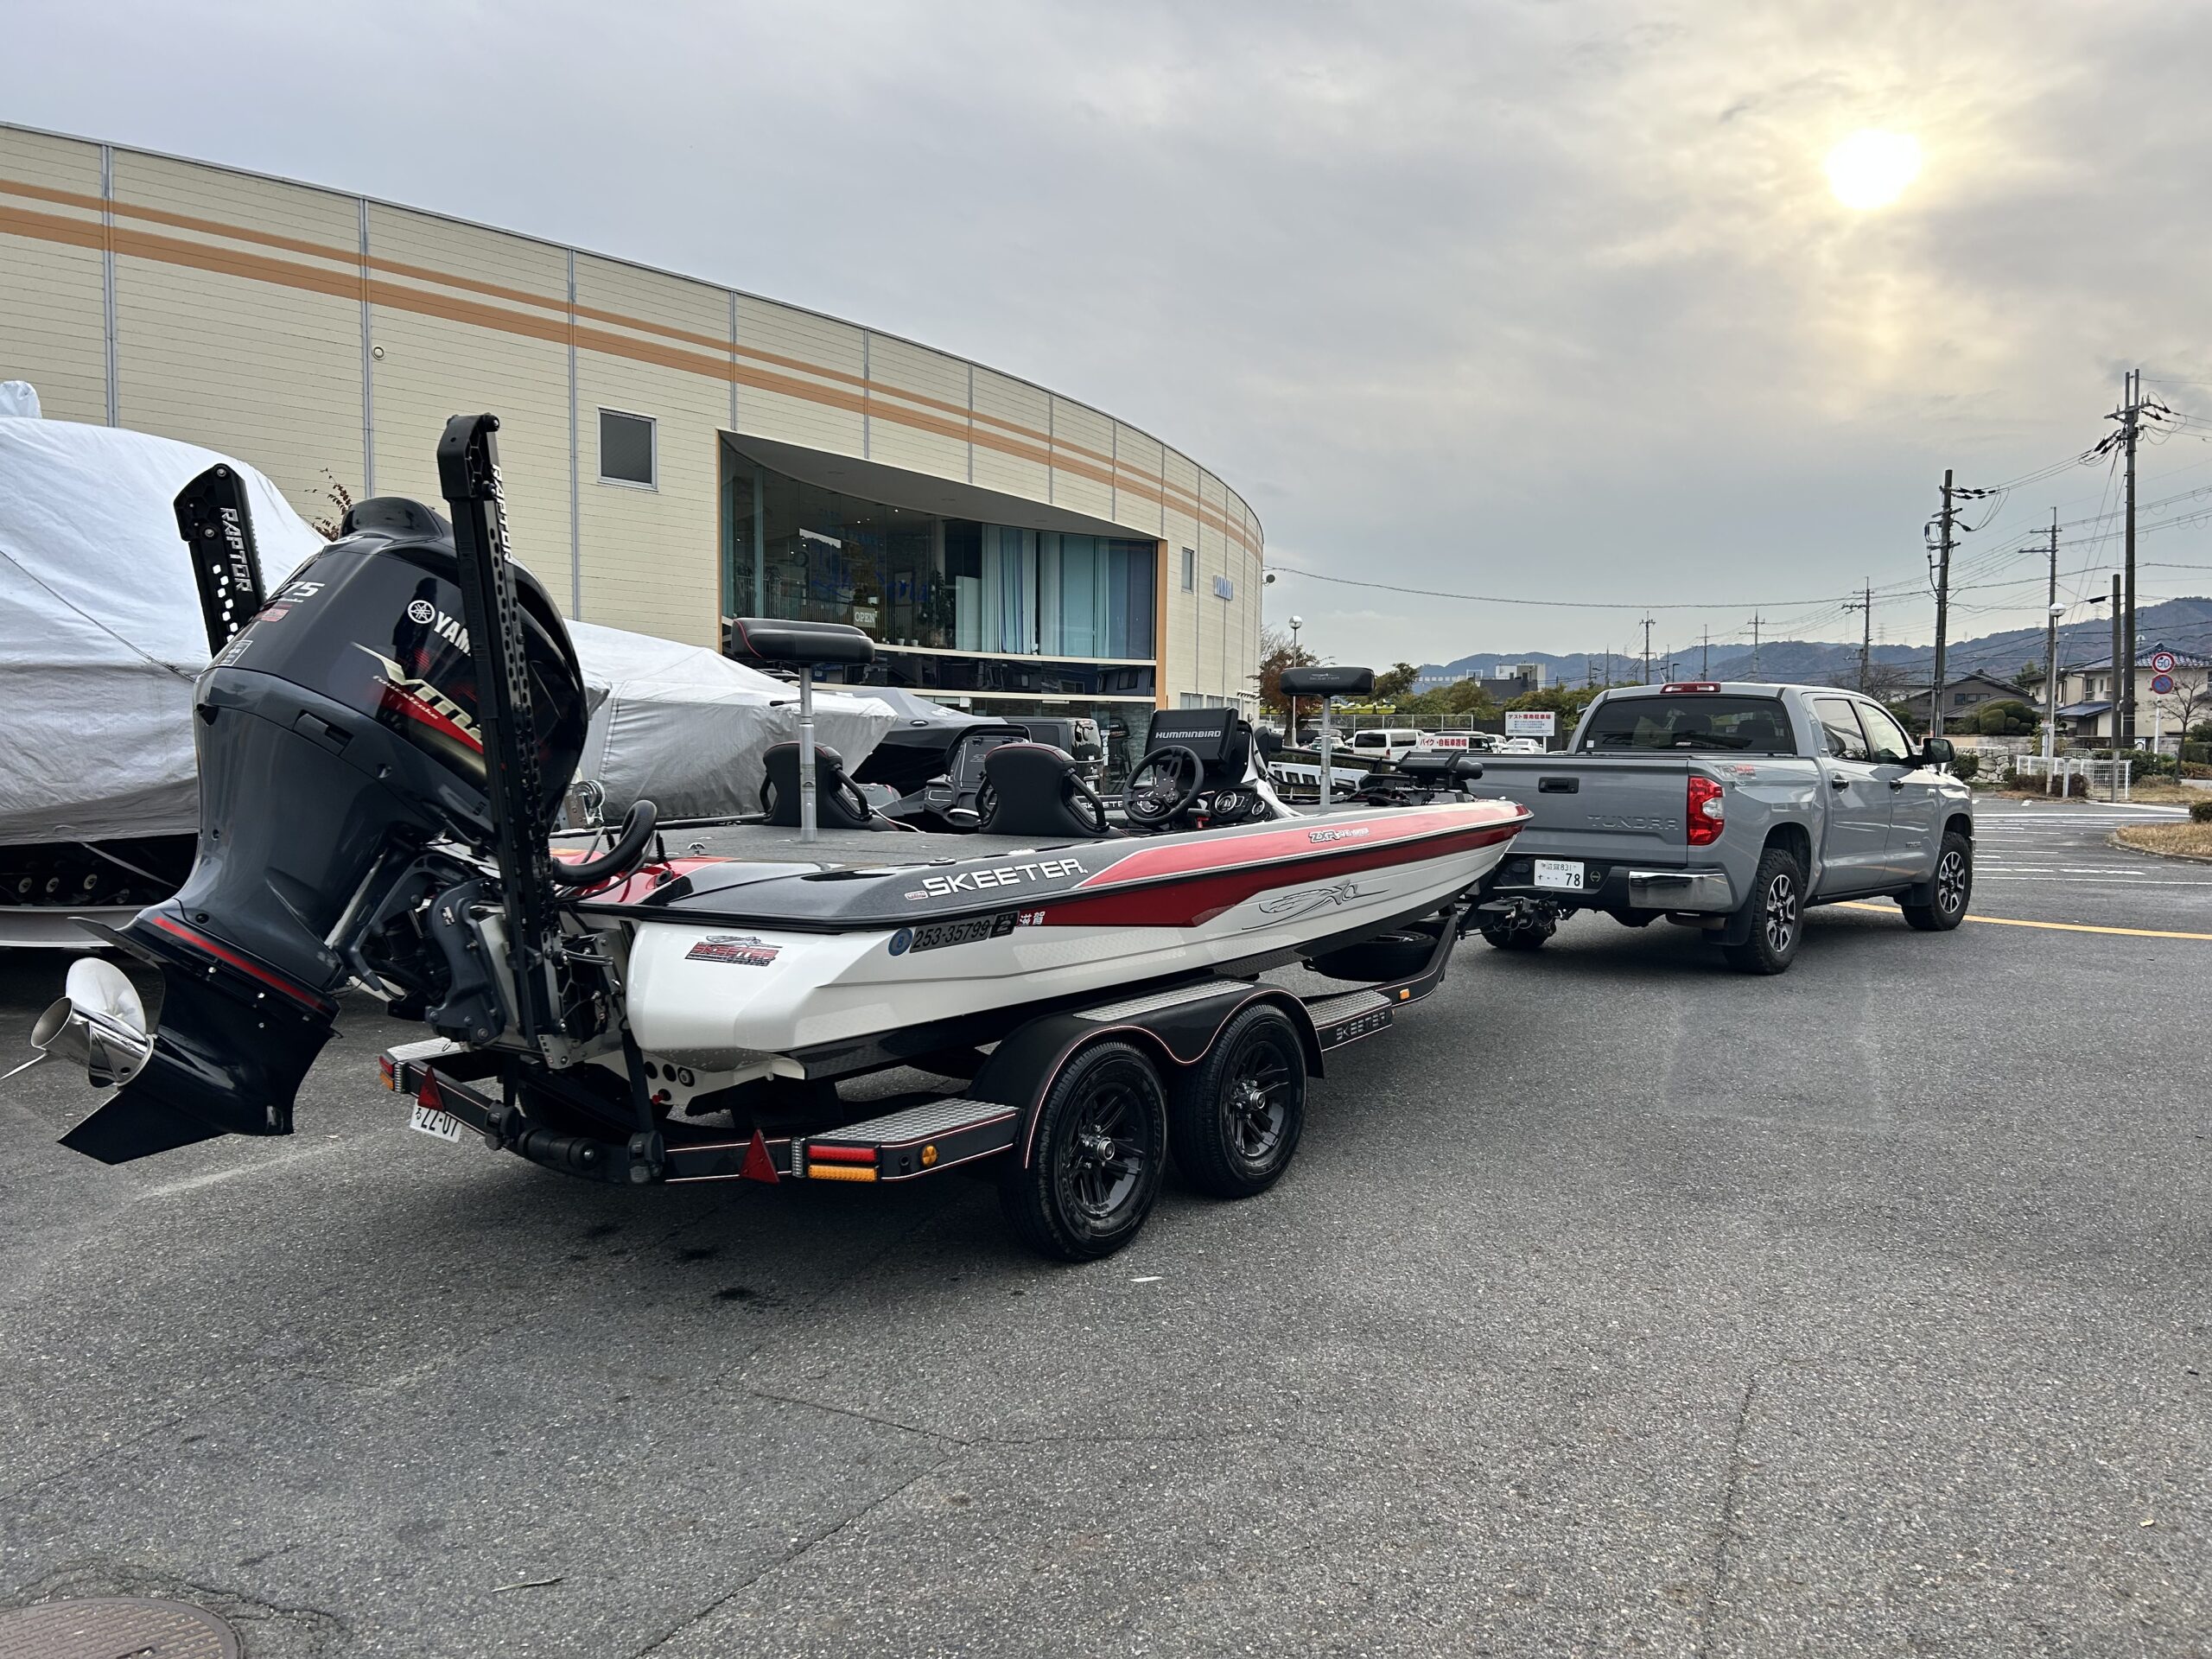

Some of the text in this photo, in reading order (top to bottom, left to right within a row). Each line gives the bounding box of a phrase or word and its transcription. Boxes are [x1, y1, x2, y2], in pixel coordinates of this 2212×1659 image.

[491, 463, 512, 563] RAPTOR
[219, 507, 253, 592] RAPTOR
[854, 611, 876, 624] OPEN
[2157, 658, 2171, 668] 50
[1155, 730, 1221, 739] HUMMINBIRD
[1587, 815, 1679, 830] TUNDRA
[922, 858, 1084, 897] SKEETER
[912, 918, 991, 949] 253-35799
[1336, 1012, 1386, 1040] SKEETER
